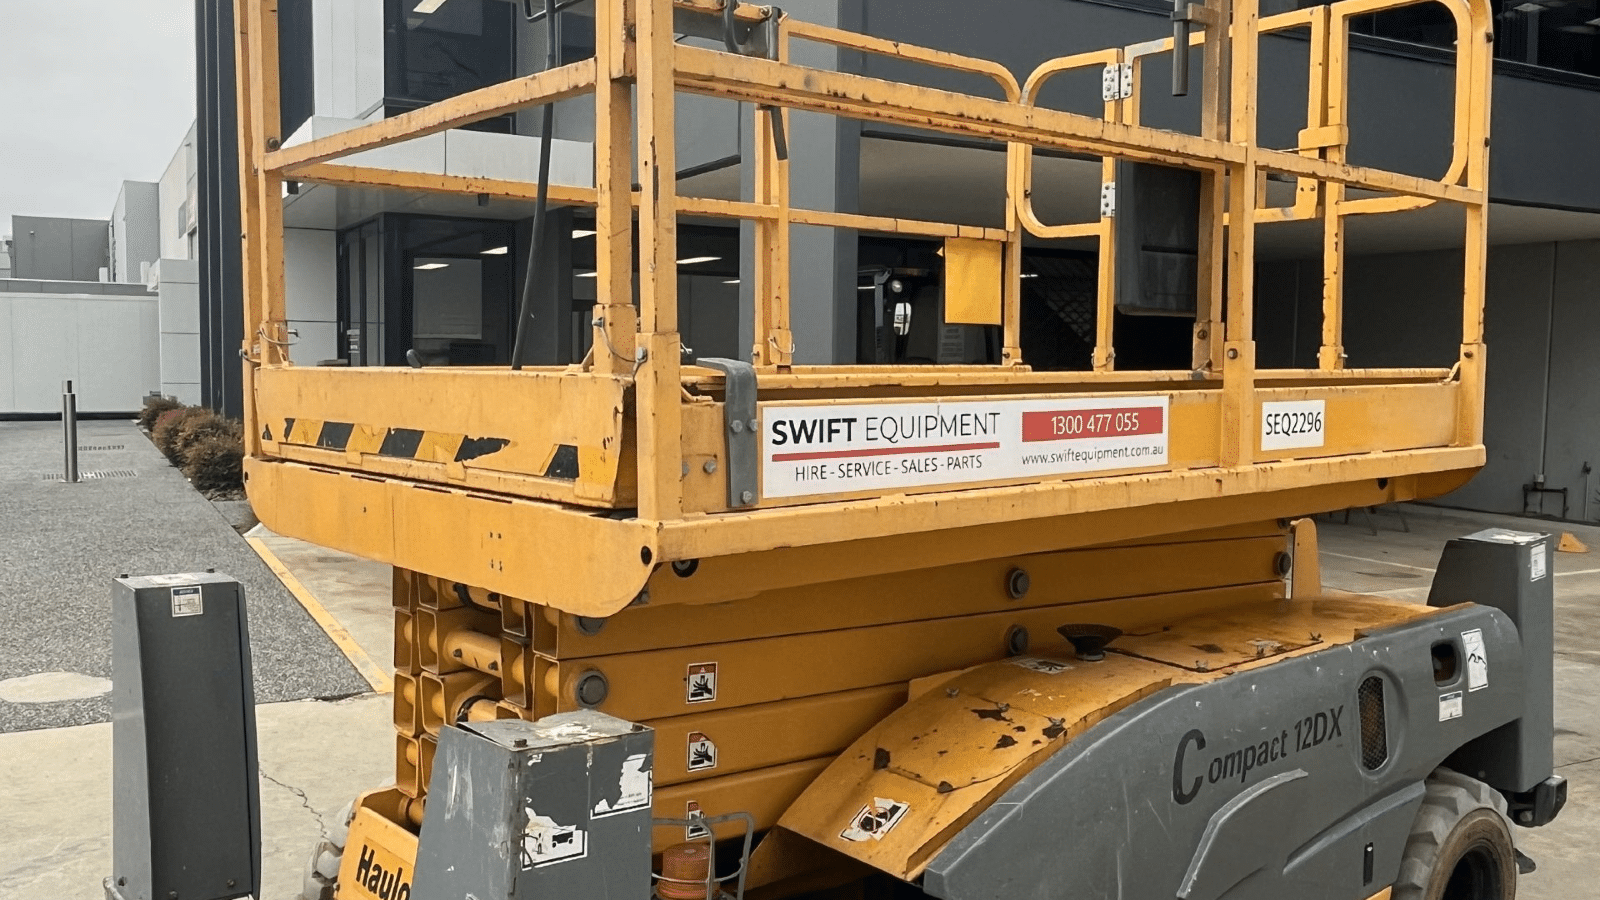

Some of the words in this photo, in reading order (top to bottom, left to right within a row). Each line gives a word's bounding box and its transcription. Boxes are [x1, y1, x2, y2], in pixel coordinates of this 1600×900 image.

[772, 418, 857, 445] SWIFT
[866, 412, 1001, 444] EQUIPMENT
[1051, 414, 1083, 435] 1300
[1086, 413, 1112, 433] 477
[1115, 412, 1140, 432] 055
[1265, 411, 1322, 437] SEQ2296
[795, 464, 828, 482] HIRE
[838, 460, 892, 479] SERVICE
[901, 457, 938, 474] SALES
[947, 454, 983, 470] PARTS
[1021, 445, 1164, 465] www.swiftequipment.com.au
[1172, 728, 1288, 806] Compact
[1294, 704, 1344, 753] 12DX
